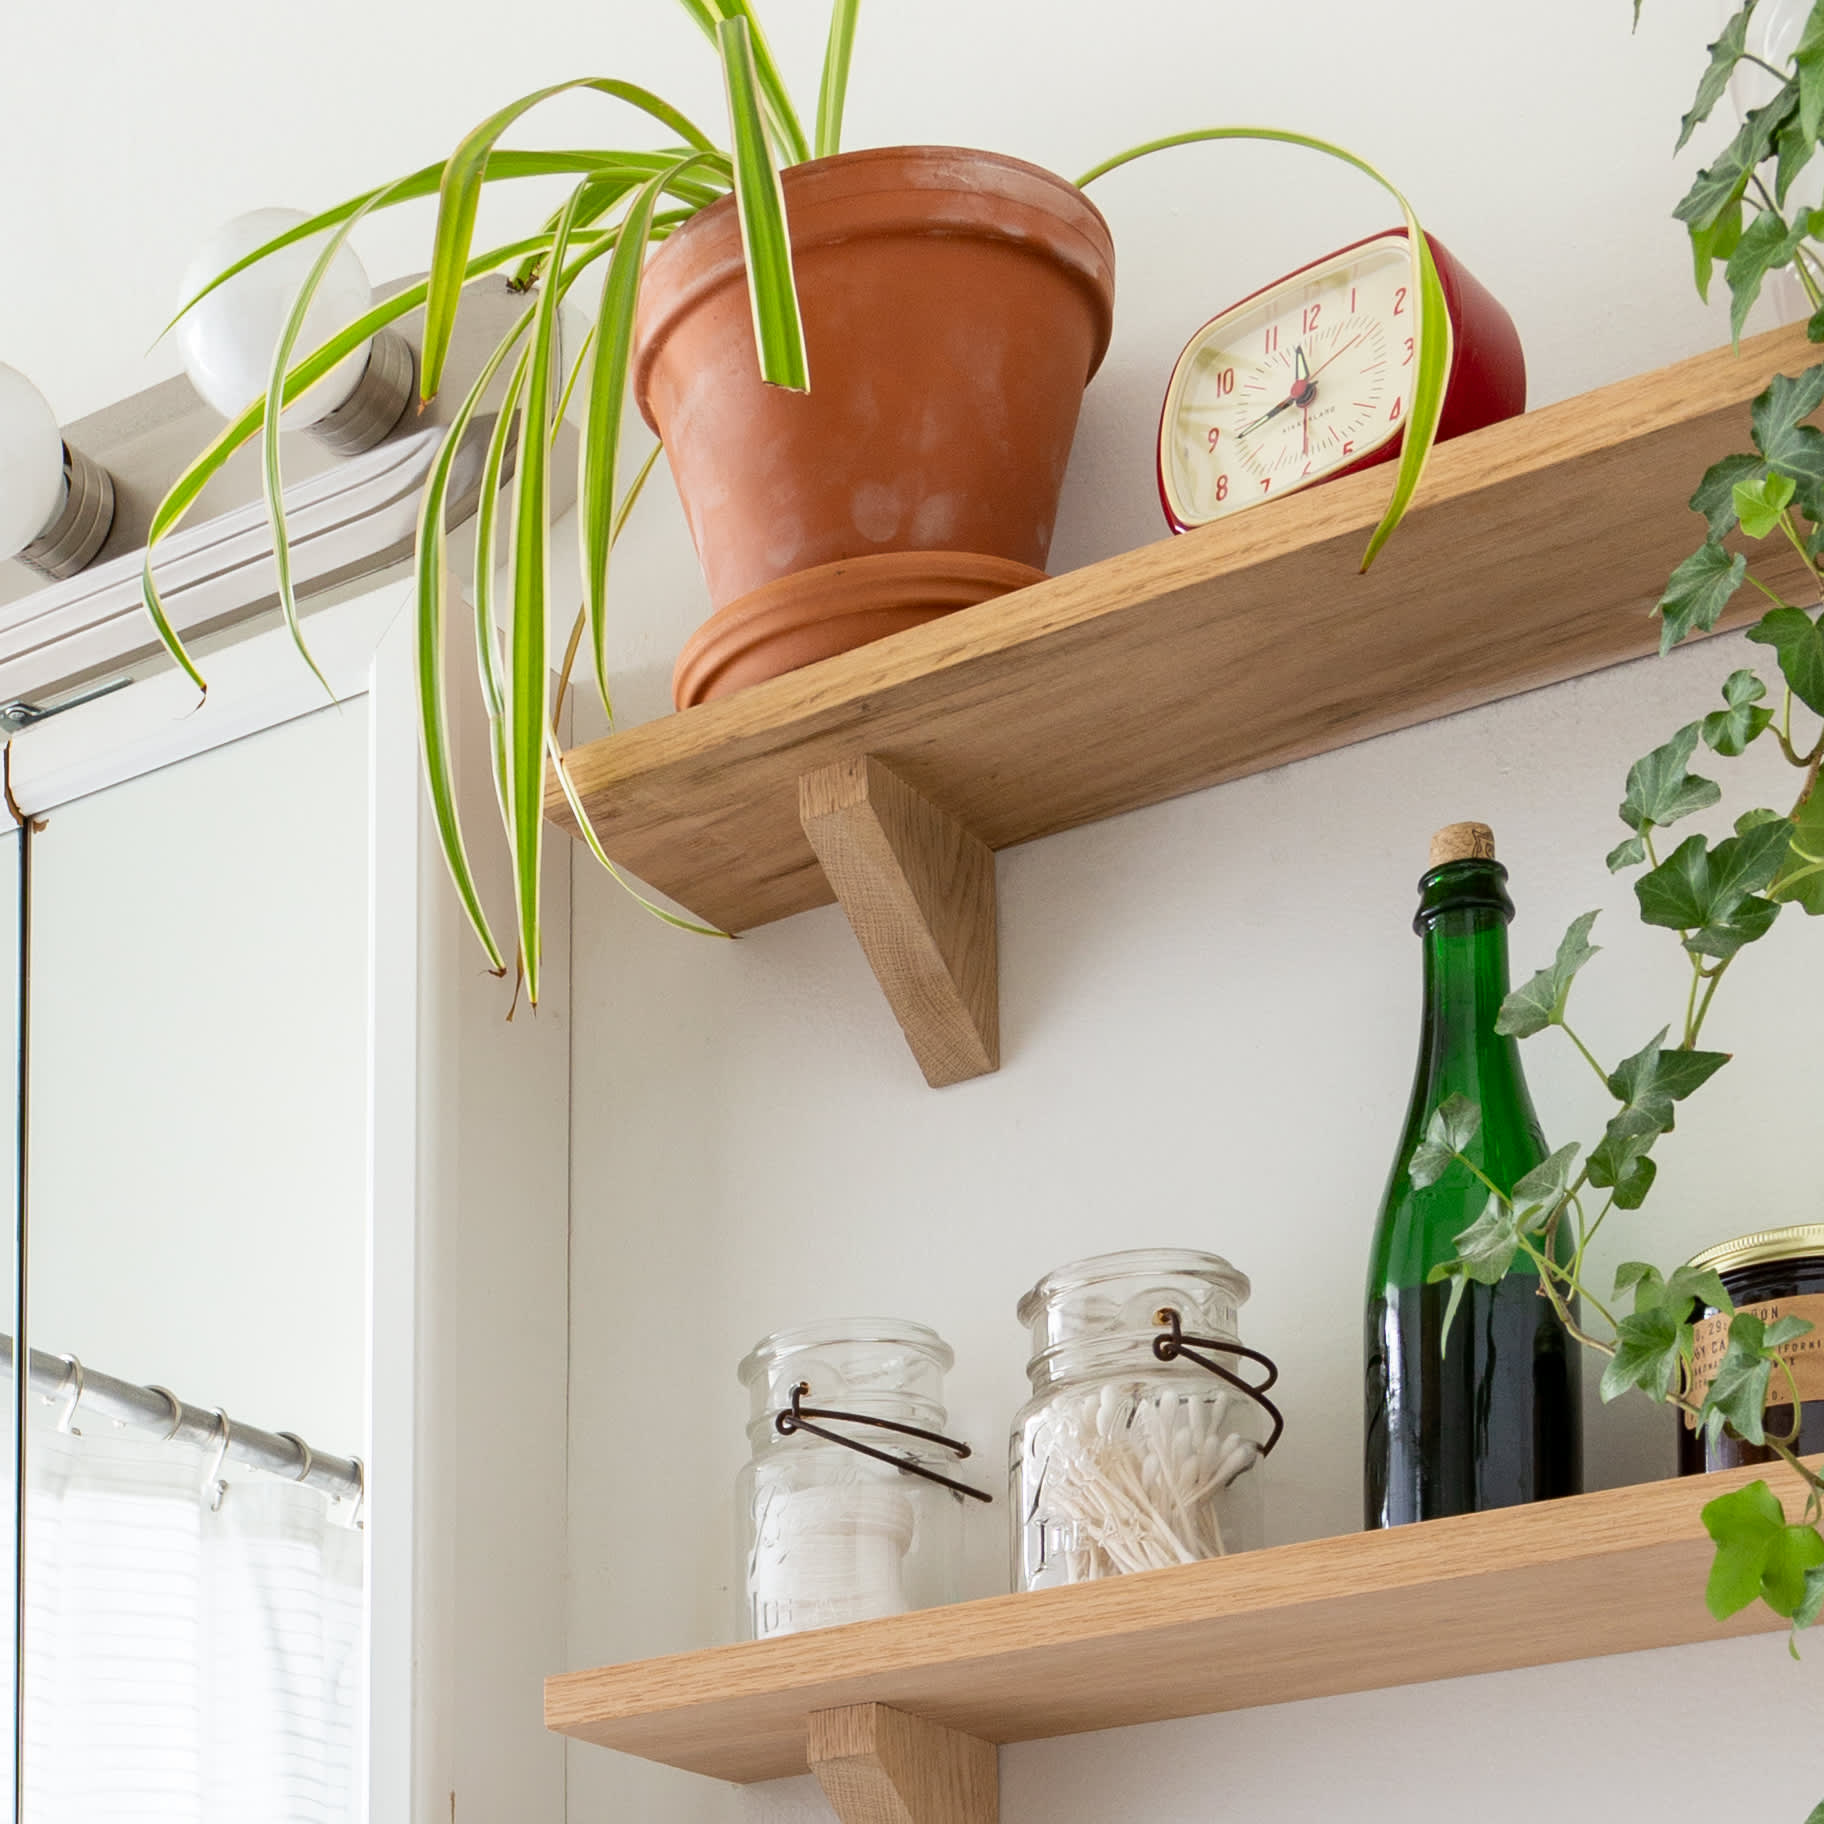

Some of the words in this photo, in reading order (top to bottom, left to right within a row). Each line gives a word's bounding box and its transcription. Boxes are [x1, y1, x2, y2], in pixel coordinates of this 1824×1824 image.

[1351, 288, 1356, 313] 1
[1393, 287, 1407, 316] 2
[1303, 304, 1321, 335] 12
[1265, 326, 1278, 354] 11
[1402, 337, 1414, 366] 3
[1216, 367, 1234, 398] 10
[1207, 427, 1220, 453] 9
[1215, 475, 1228, 502] 8
